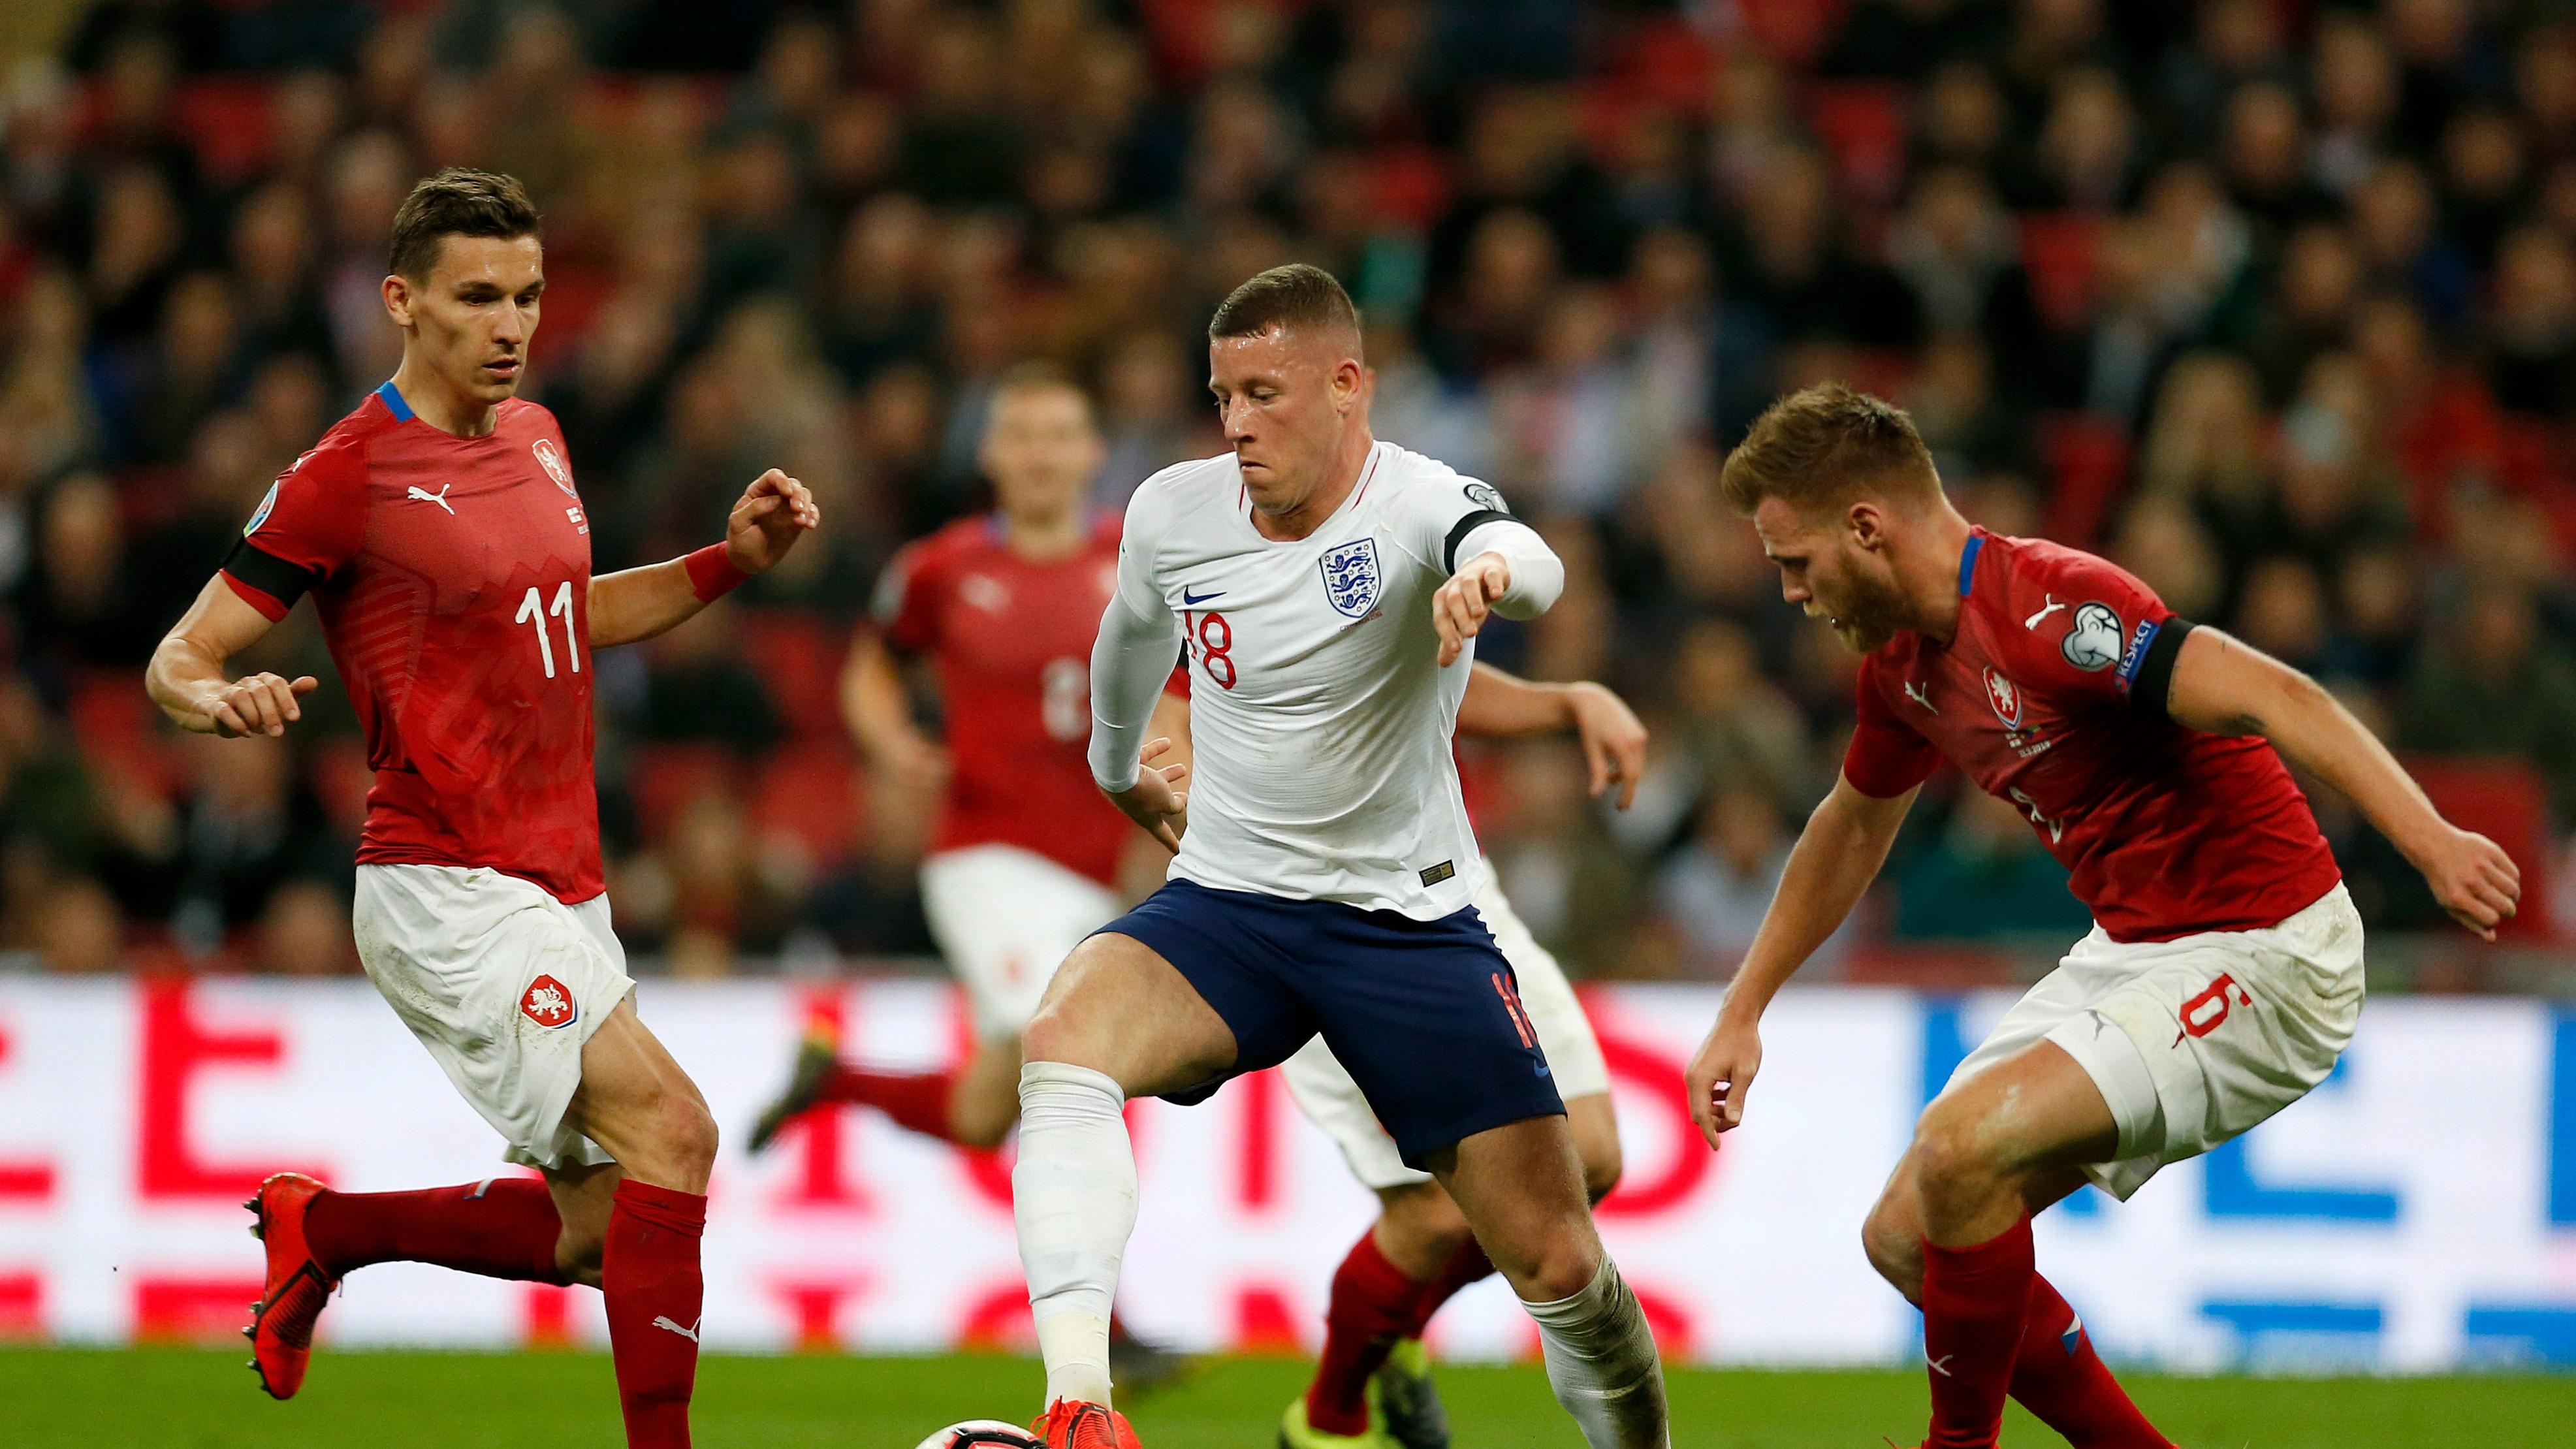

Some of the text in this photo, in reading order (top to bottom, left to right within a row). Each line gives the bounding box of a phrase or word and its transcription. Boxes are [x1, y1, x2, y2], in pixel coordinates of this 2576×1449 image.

[515, 581, 580, 678] 11
[1183, 610, 1237, 690] 18
[2116, 618, 2153, 677] RESPECT
[2179, 972, 2252, 1038] 6
